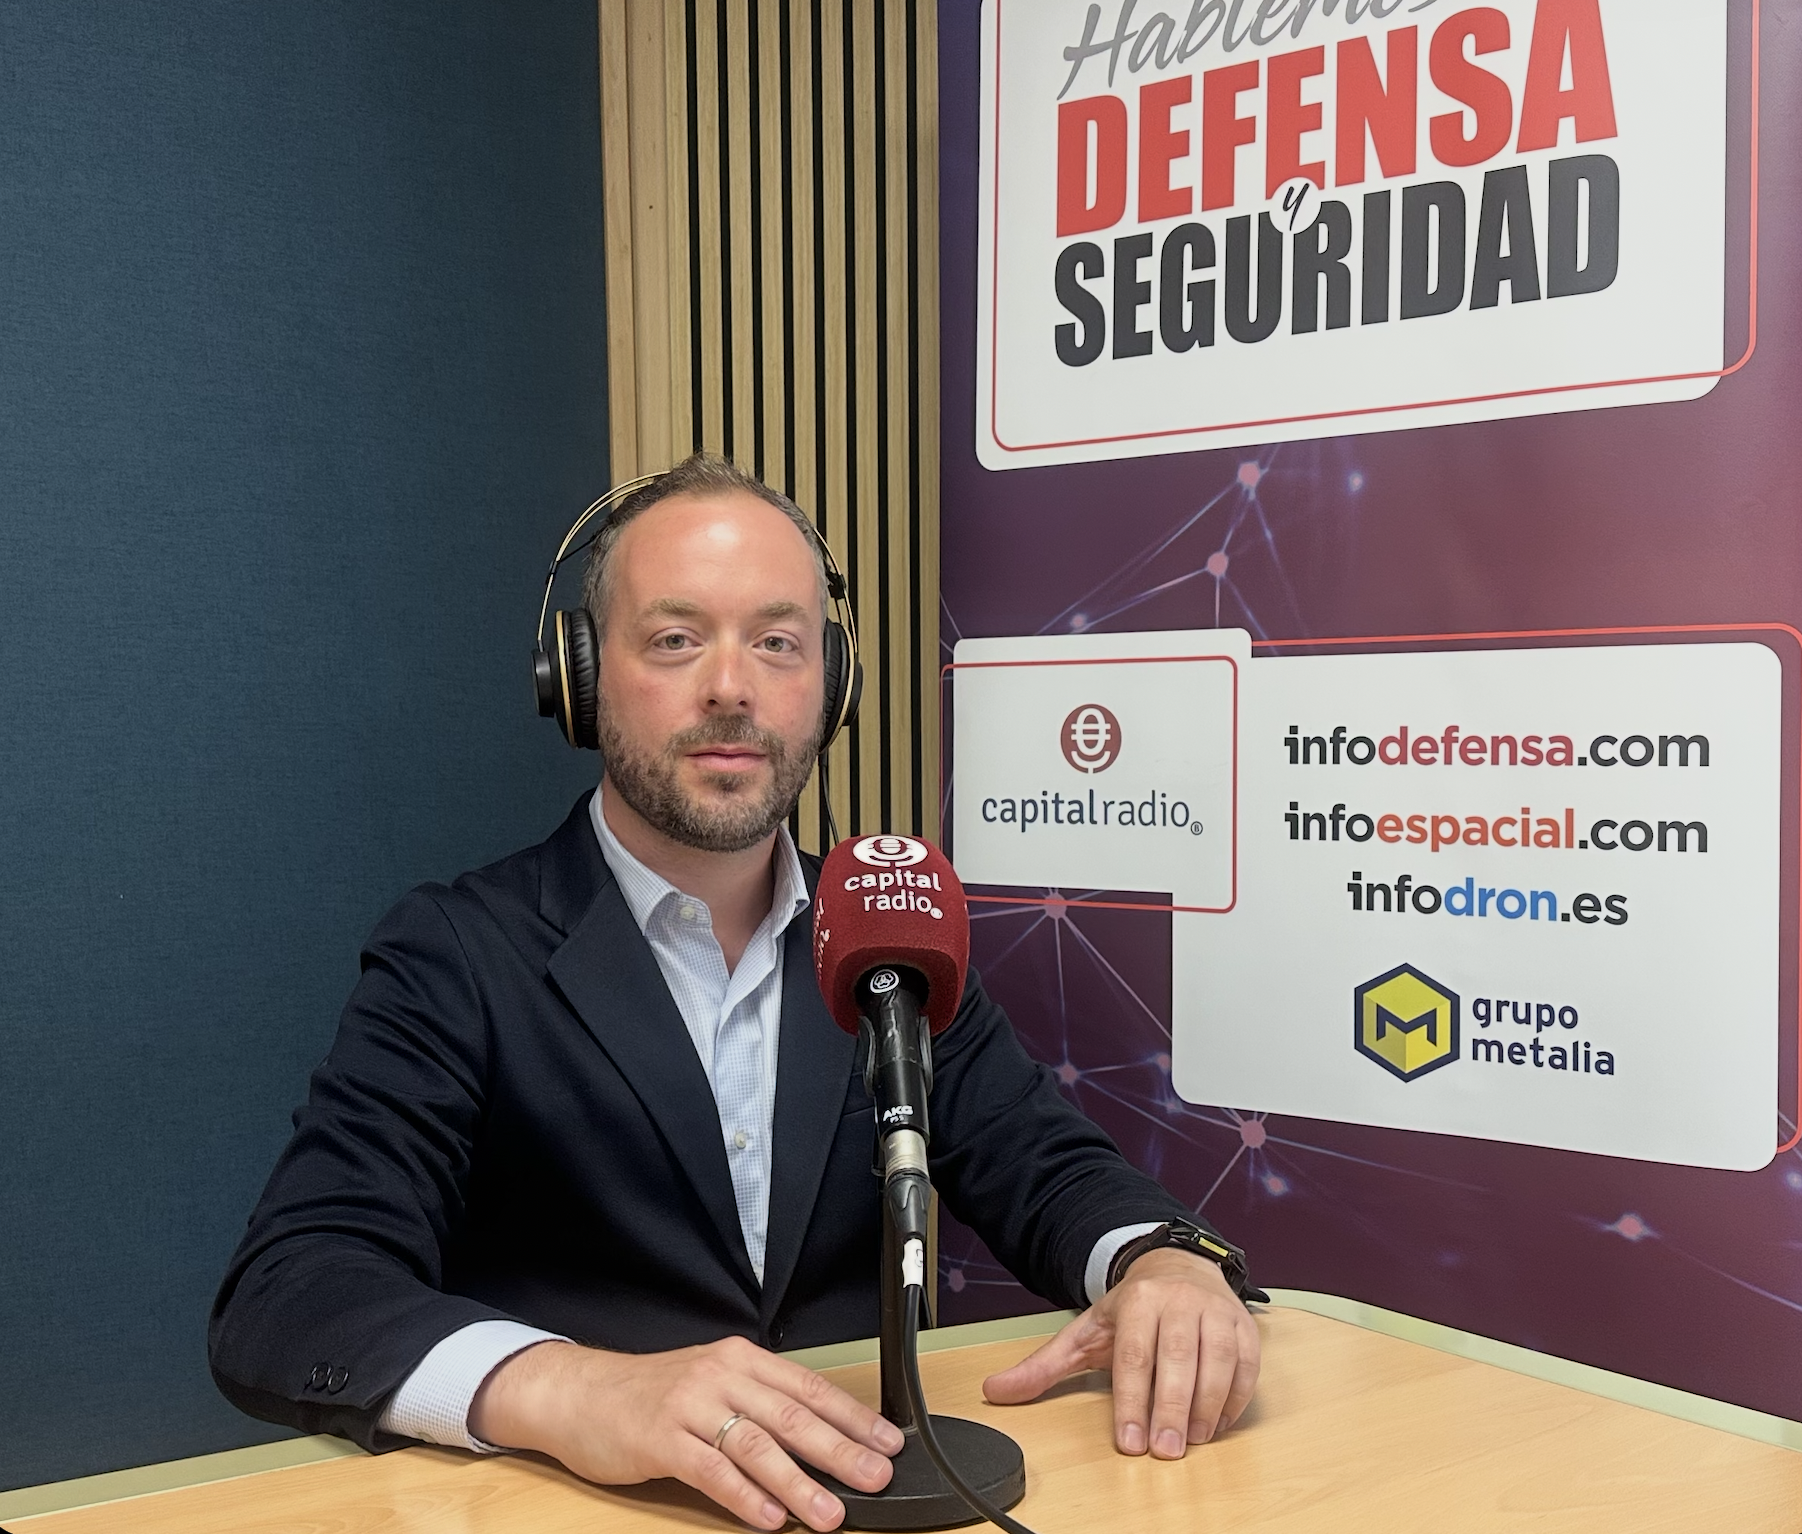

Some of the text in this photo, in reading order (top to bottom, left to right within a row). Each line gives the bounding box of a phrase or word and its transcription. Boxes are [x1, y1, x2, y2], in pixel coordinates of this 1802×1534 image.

[1056, 0, 1618, 238] DEFENSA
[1283, 183, 1310, 231] y
[1055, 154, 1620, 367] SEGURIDAD
[1284, 725, 1710, 767] infodefensa.com
[1284, 802, 1708, 853] infoespacial.com
[844, 869, 943, 891] capital
[1347, 871, 1629, 925] infodron.es
[1472, 998, 1579, 1033] grupo
[1472, 1037, 1614, 1076] metalia
